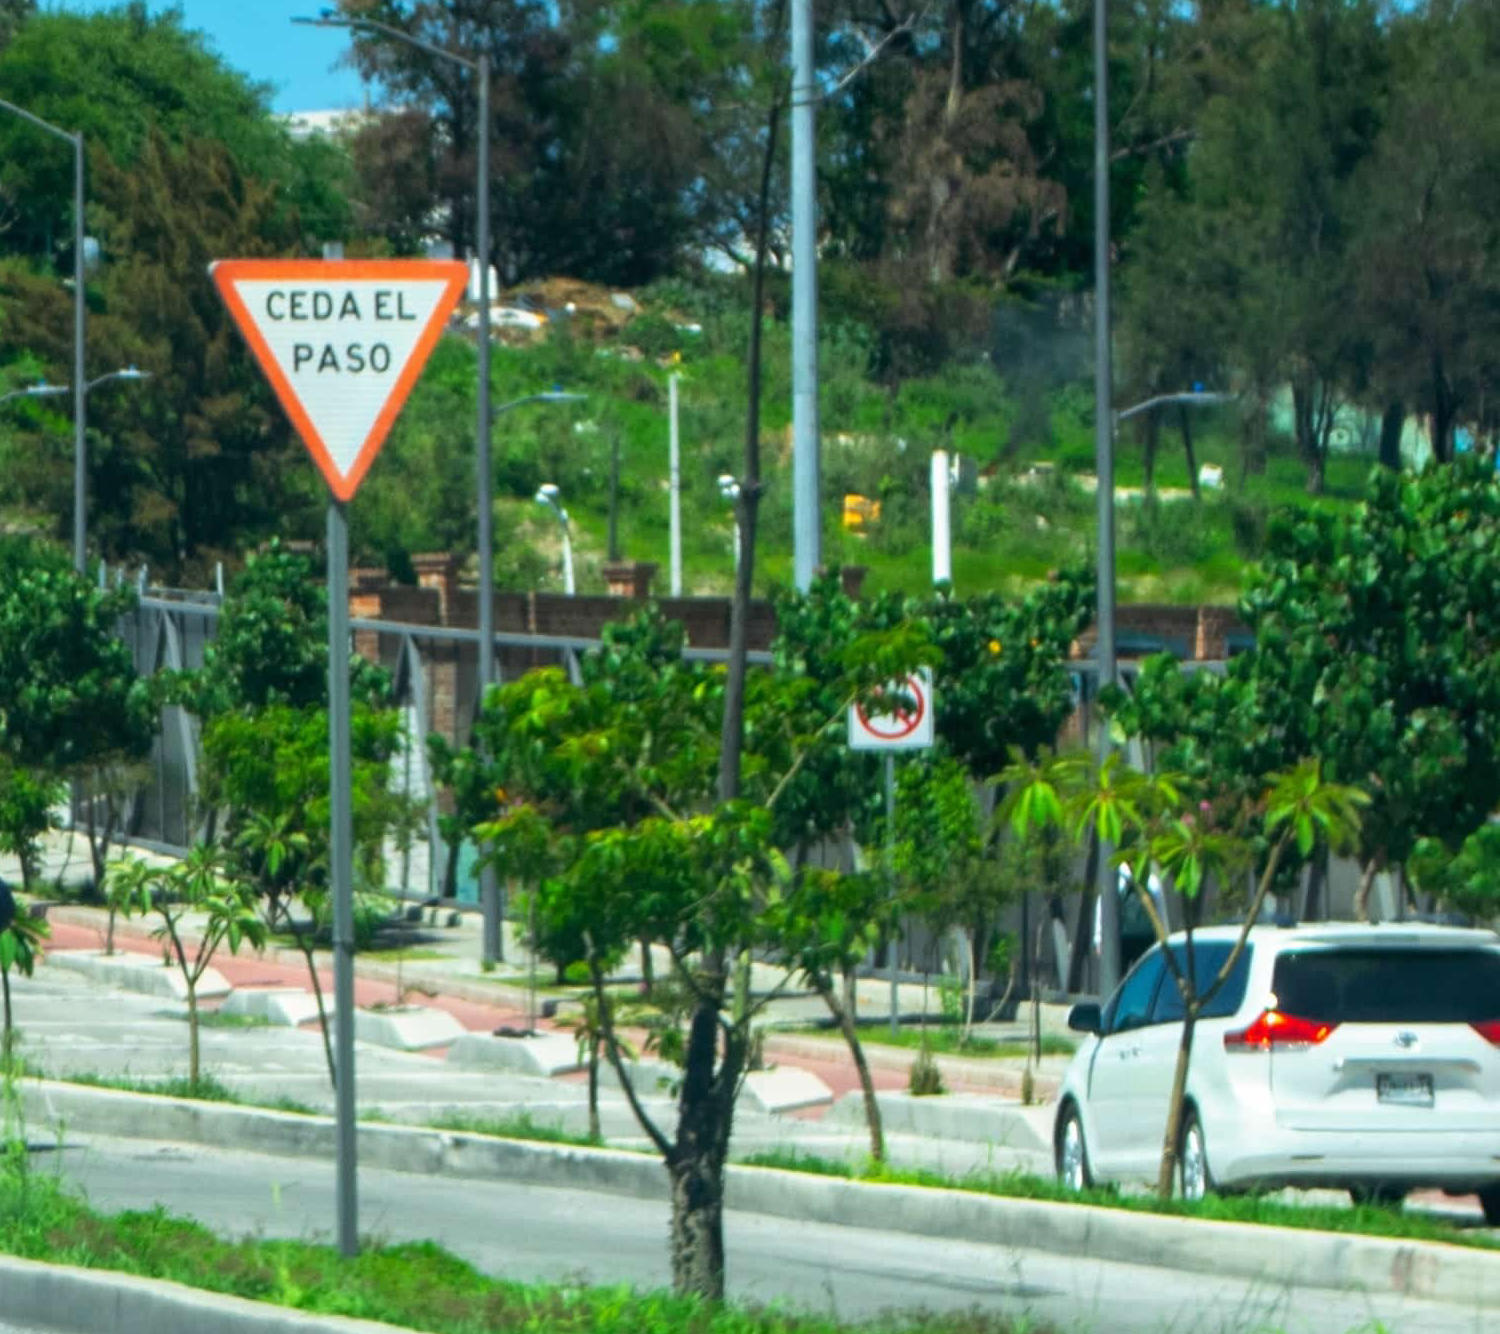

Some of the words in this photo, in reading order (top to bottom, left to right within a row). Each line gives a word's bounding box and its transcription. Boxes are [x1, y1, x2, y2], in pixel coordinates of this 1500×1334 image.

[266, 291, 361, 321] CEDA
[375, 291, 417, 320] EL
[293, 343, 391, 373] PASO
